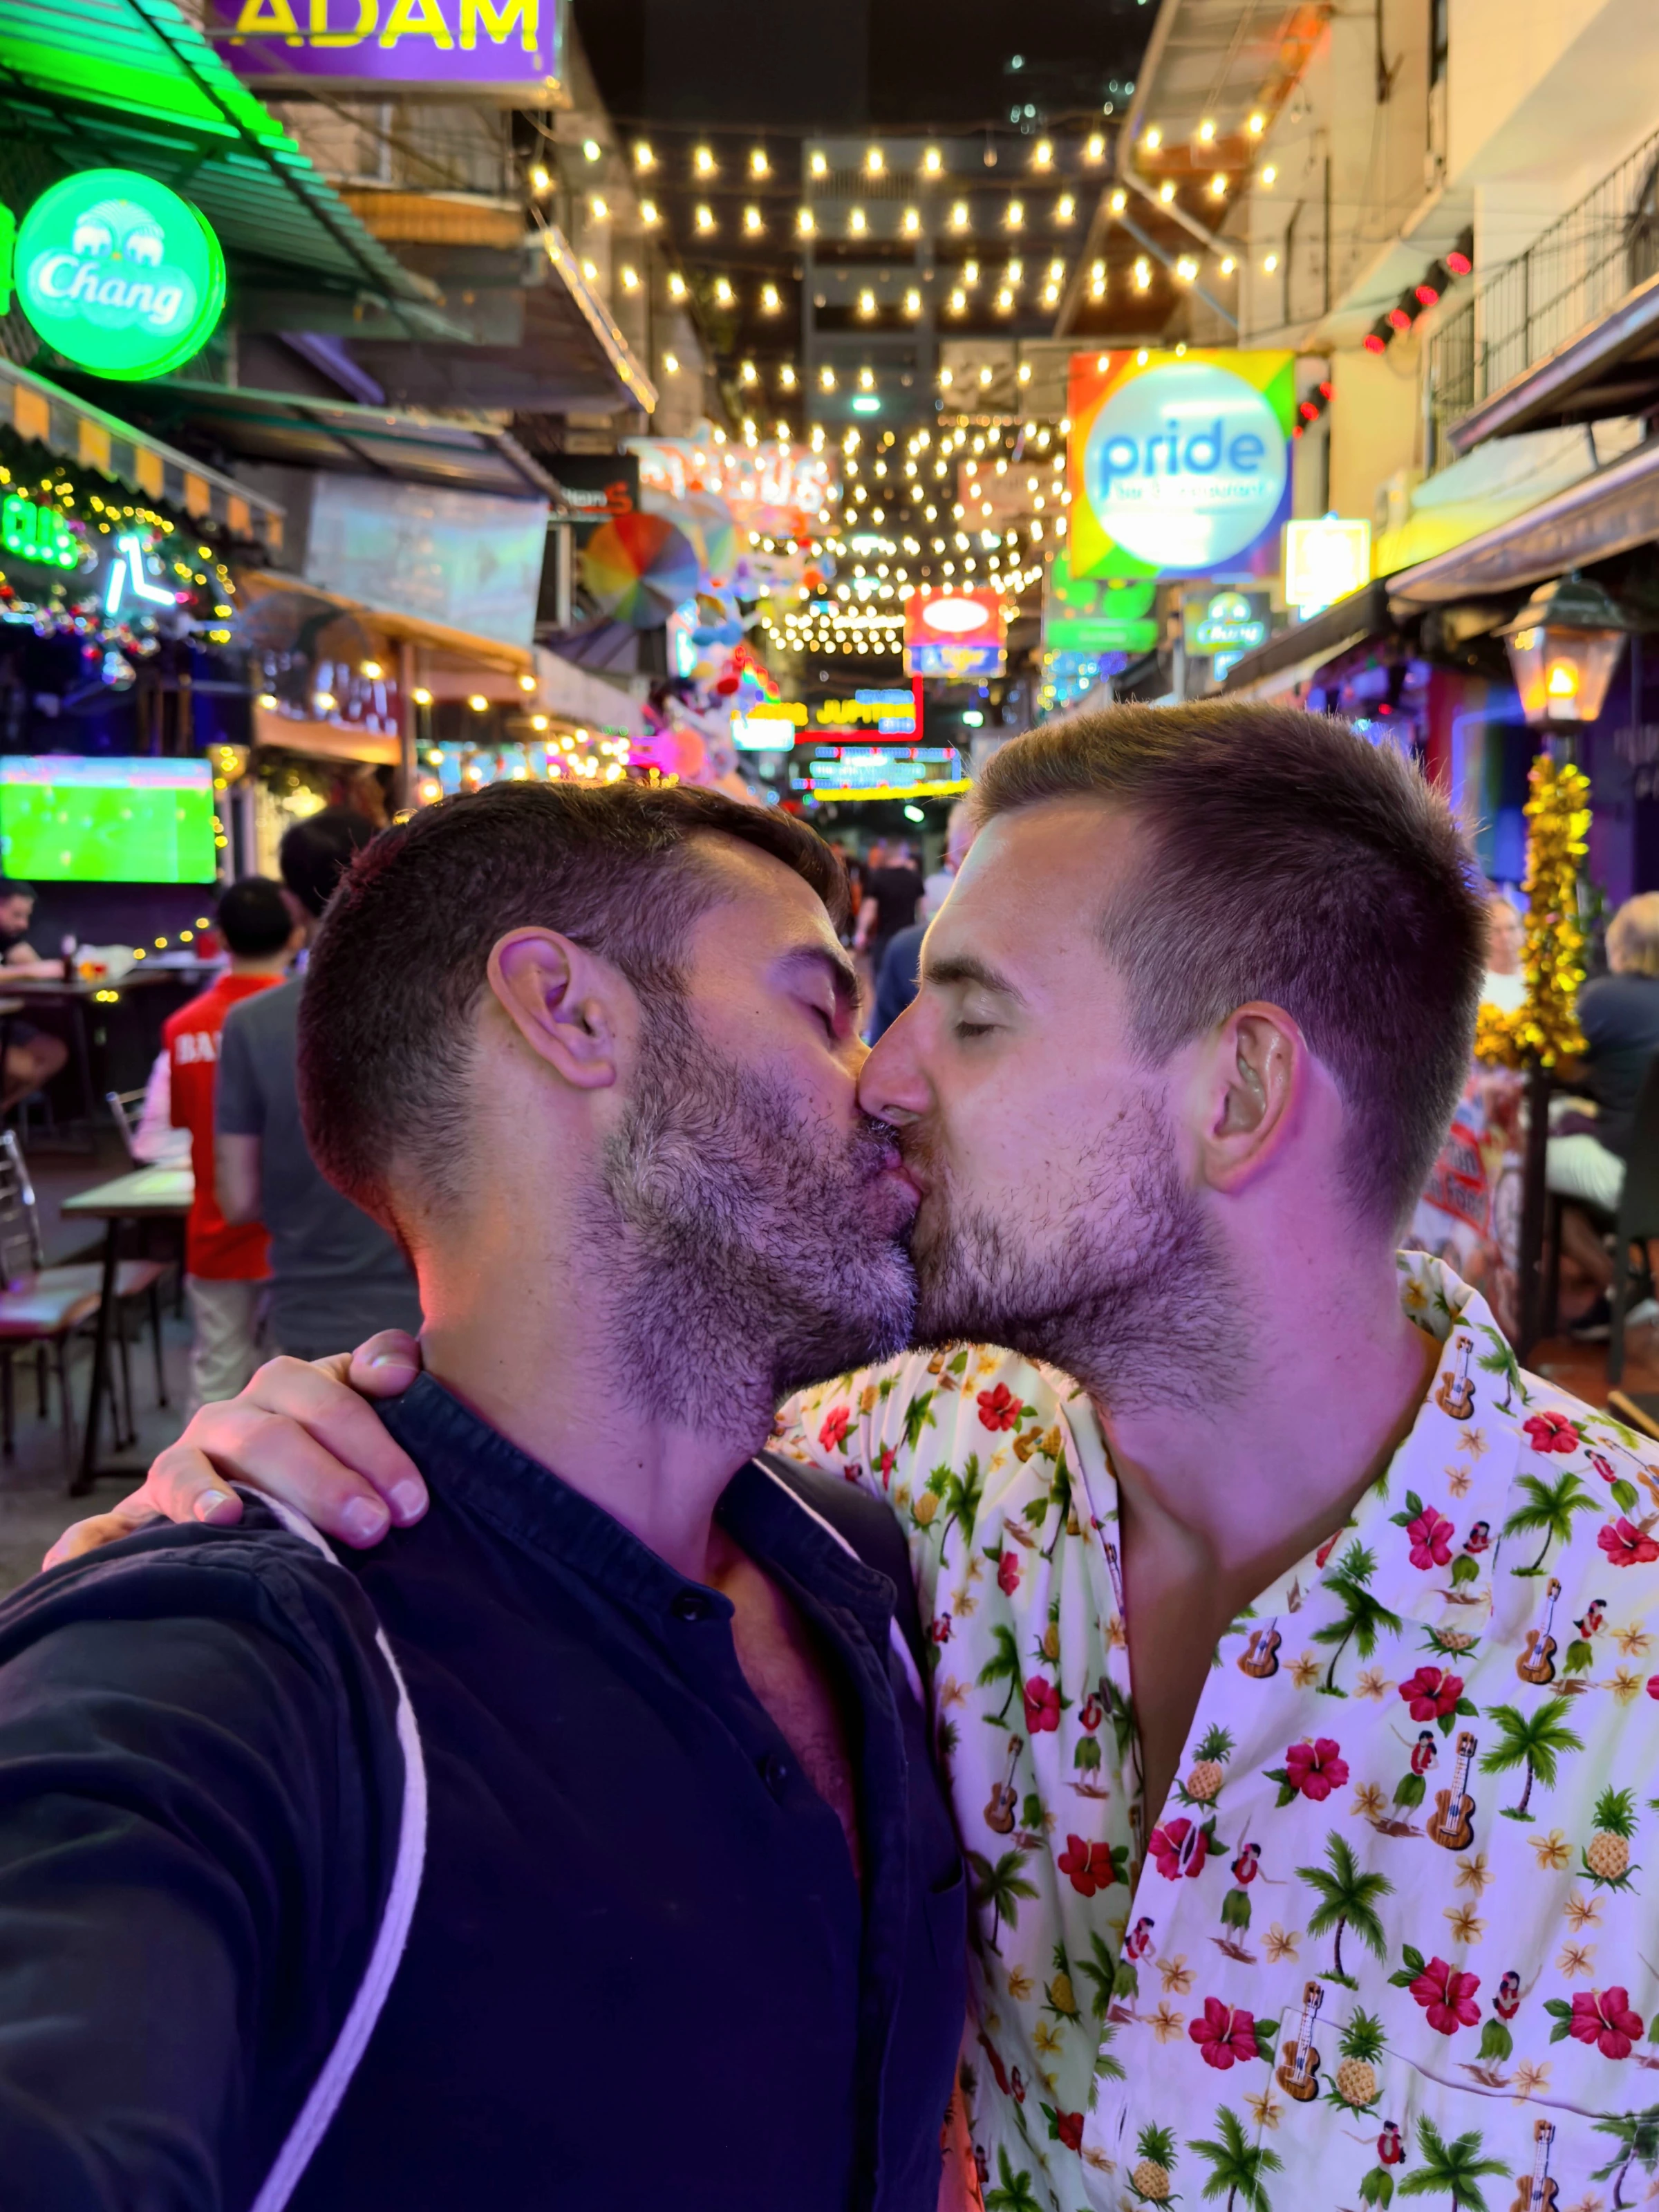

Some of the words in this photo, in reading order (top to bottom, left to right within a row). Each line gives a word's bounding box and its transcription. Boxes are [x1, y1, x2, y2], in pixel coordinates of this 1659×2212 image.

[229, 0, 538, 51] ADAM
[38, 254, 182, 325] Chang
[1100, 417, 1264, 500] pride
